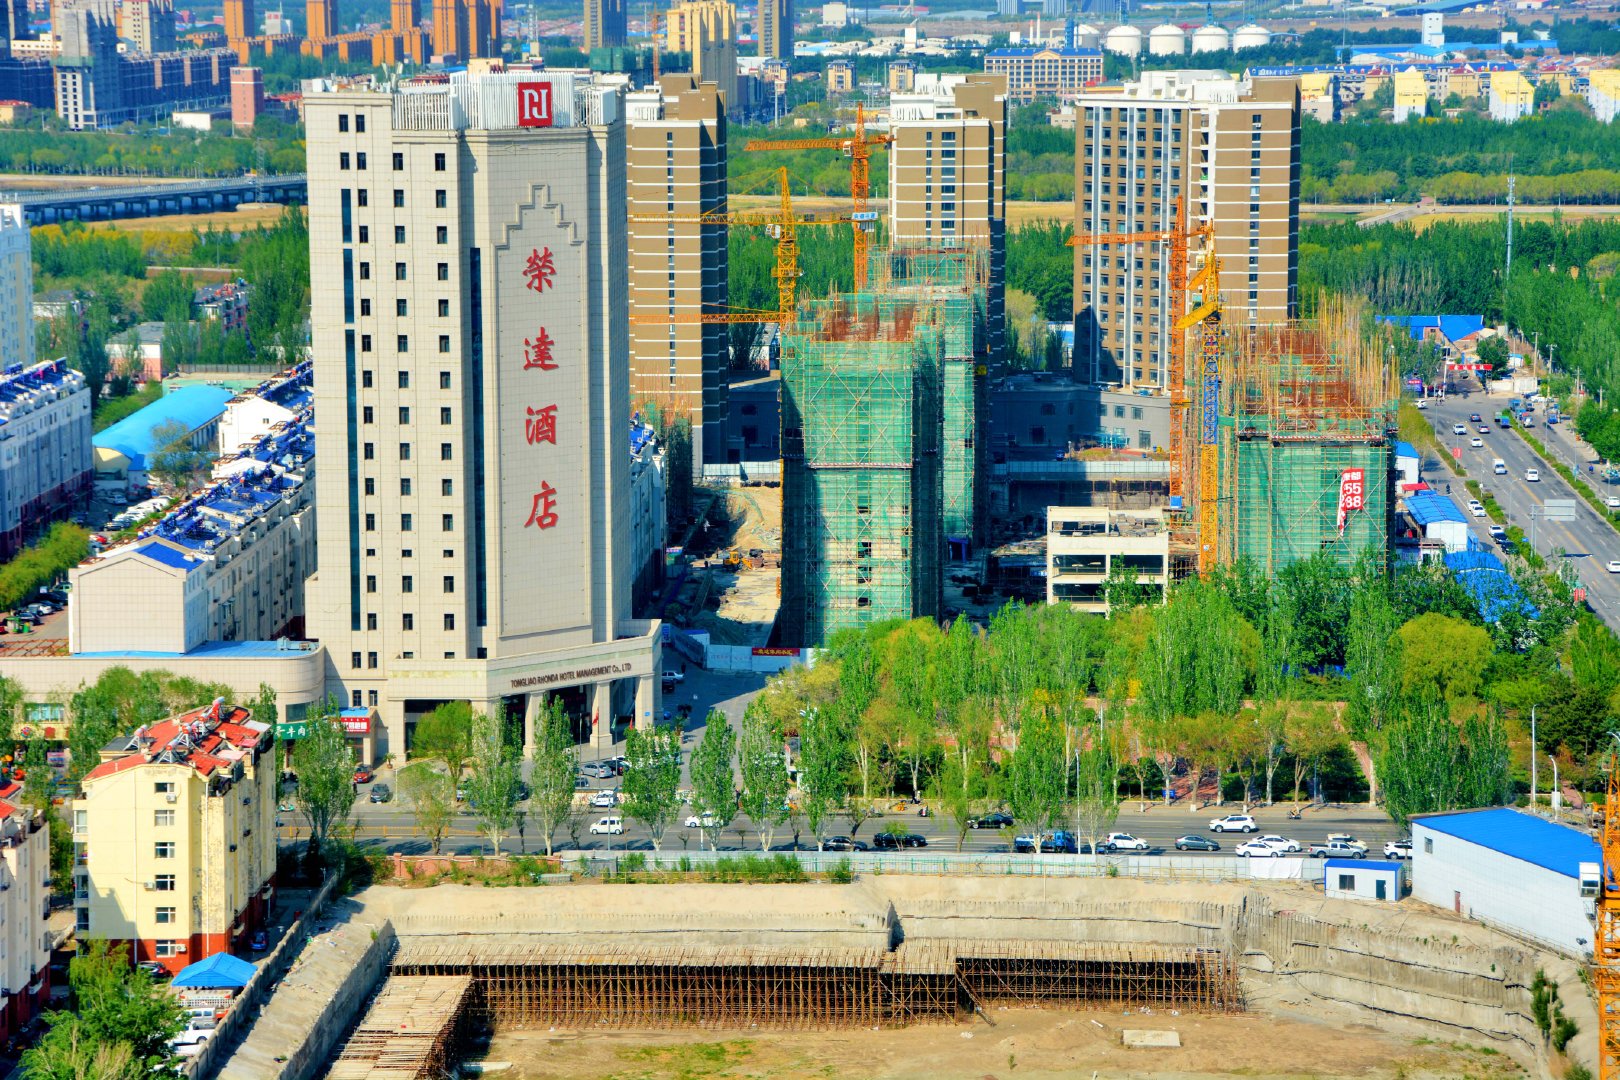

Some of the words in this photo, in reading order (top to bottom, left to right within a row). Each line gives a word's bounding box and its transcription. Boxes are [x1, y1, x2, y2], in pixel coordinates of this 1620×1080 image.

[523, 247, 558, 529] 榮達酒店
[511, 677, 537, 688] TONGLIAO
[559, 671, 575, 681] HOTEL
[576, 665, 611, 678] MANAGEMENT
[621, 662, 632, 672] LTD
